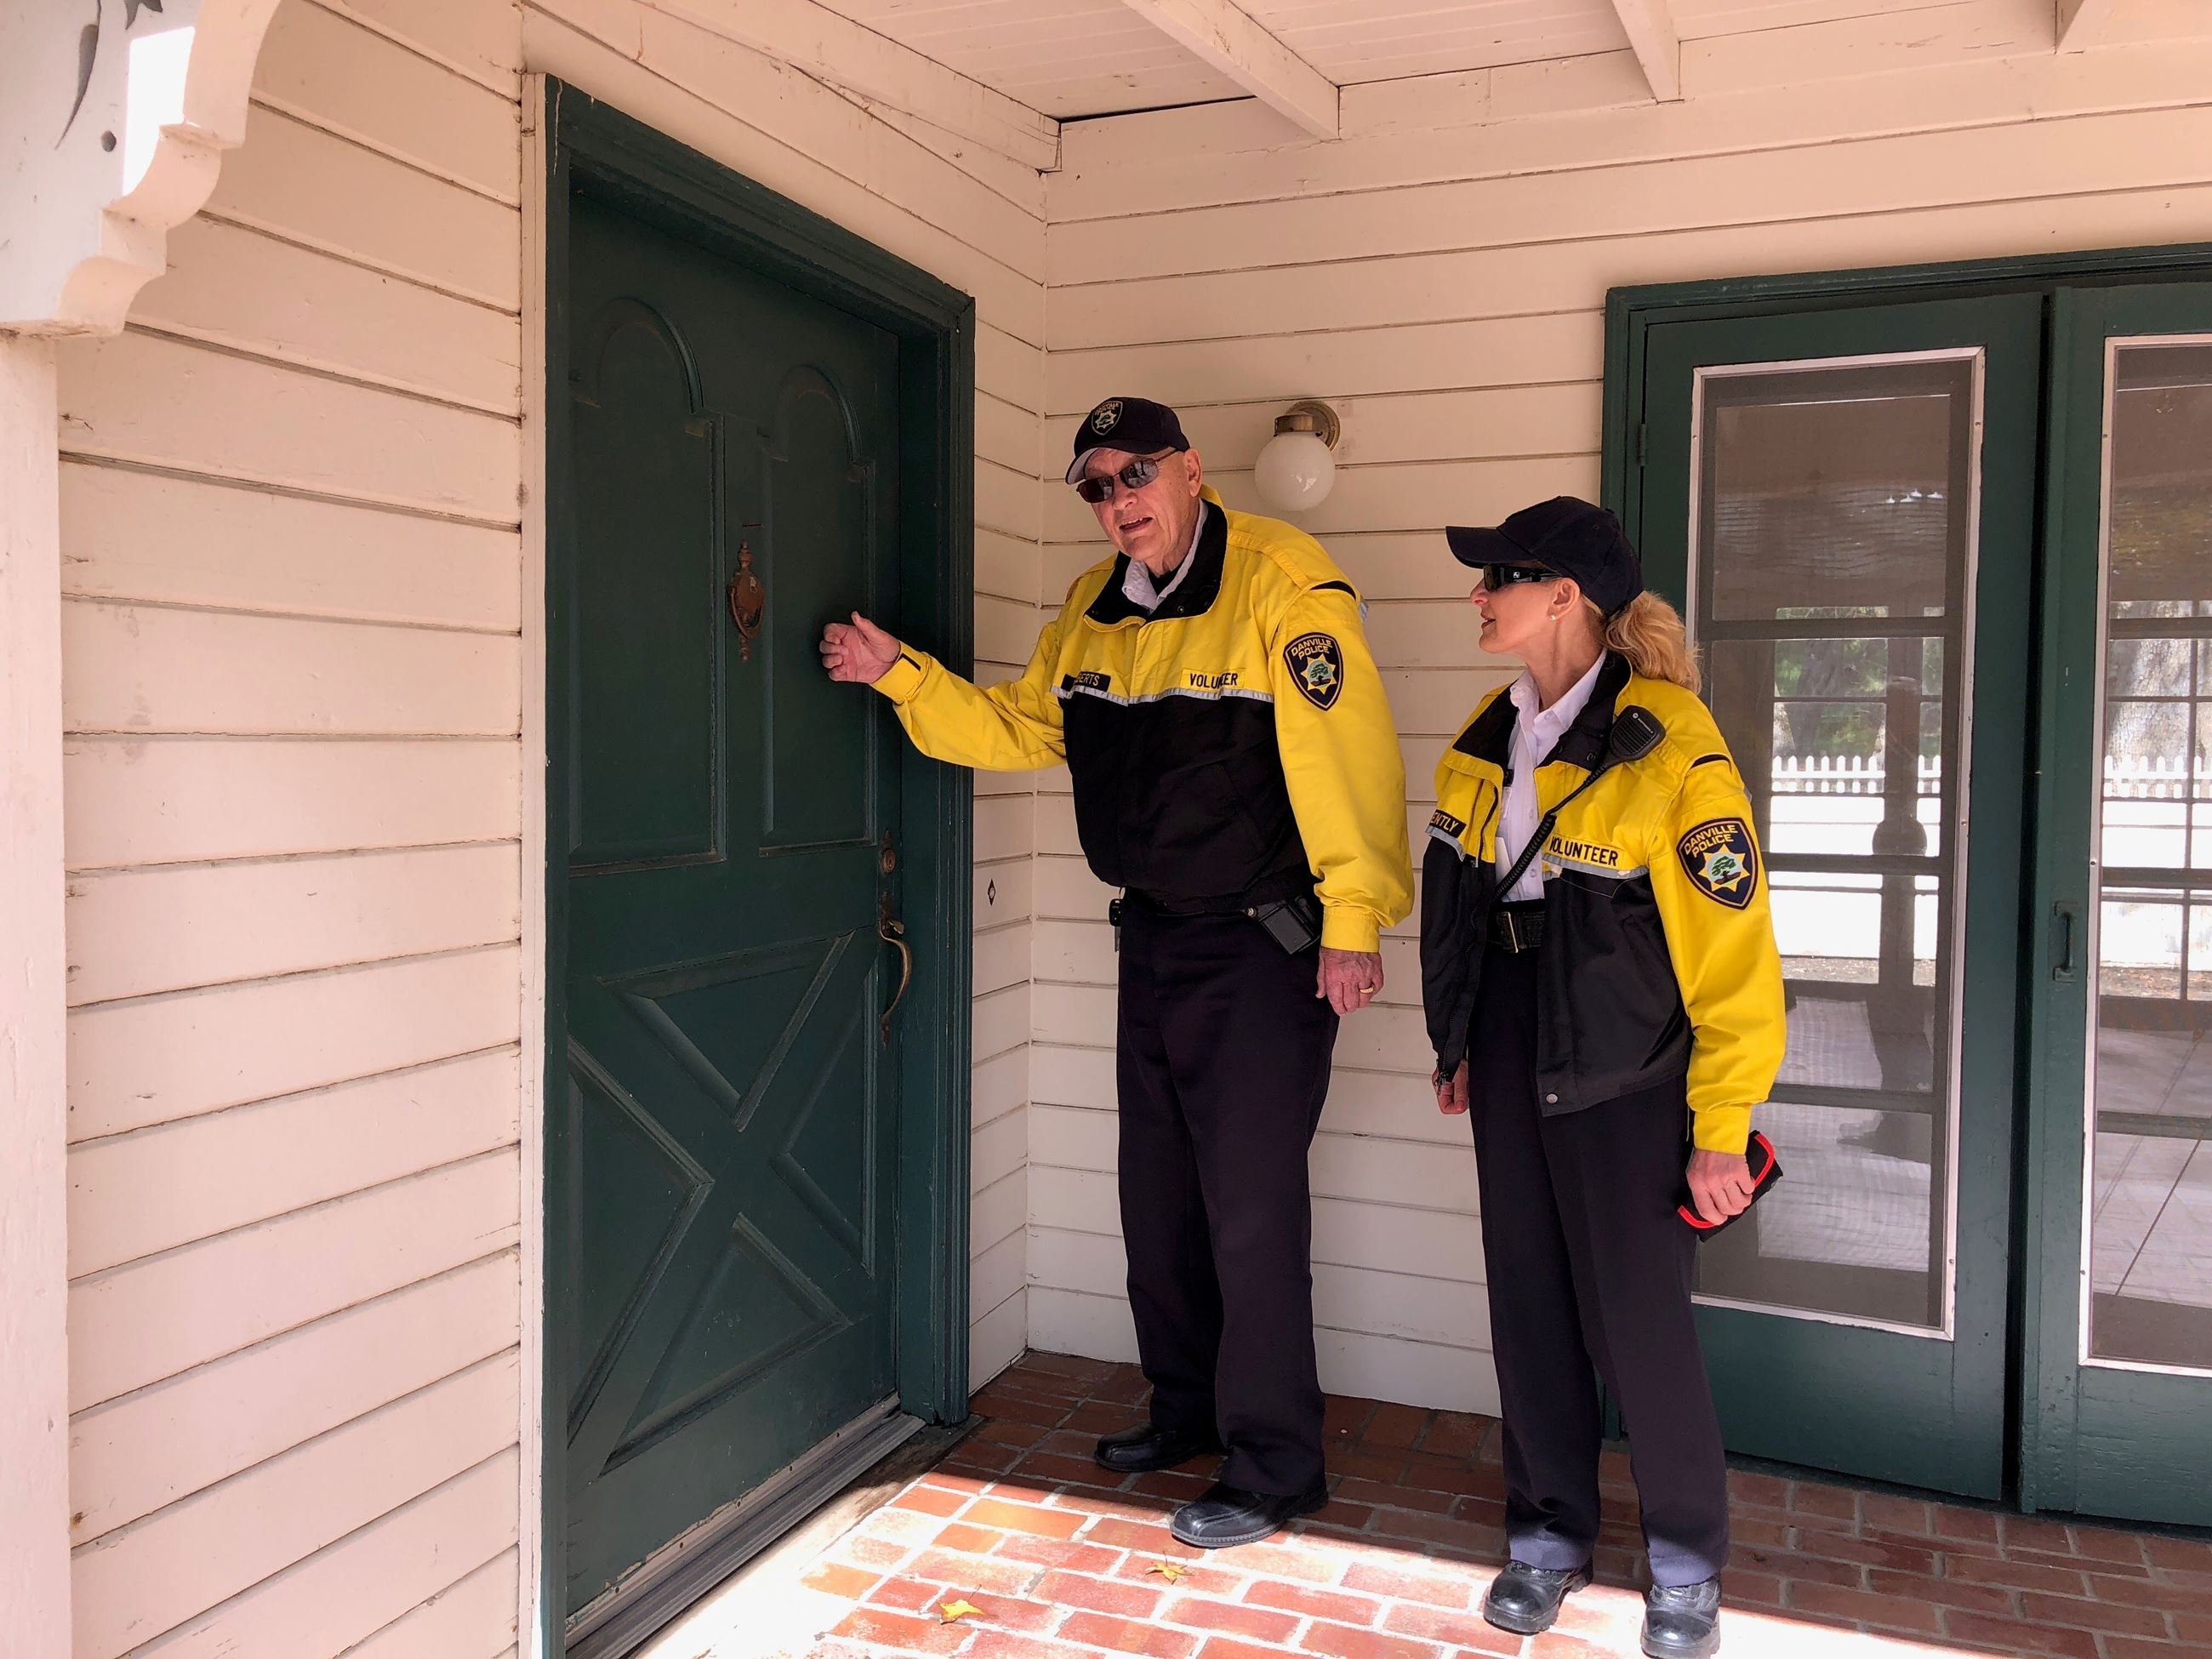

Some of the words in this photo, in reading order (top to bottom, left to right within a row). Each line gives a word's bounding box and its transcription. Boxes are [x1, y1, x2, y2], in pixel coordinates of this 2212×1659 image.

[1291, 638, 1333, 657] DANVILLE
[1298, 645, 1330, 660] POLICE
[1685, 824, 1738, 855] DANVILLE
[1691, 834, 1734, 858] POLICE
